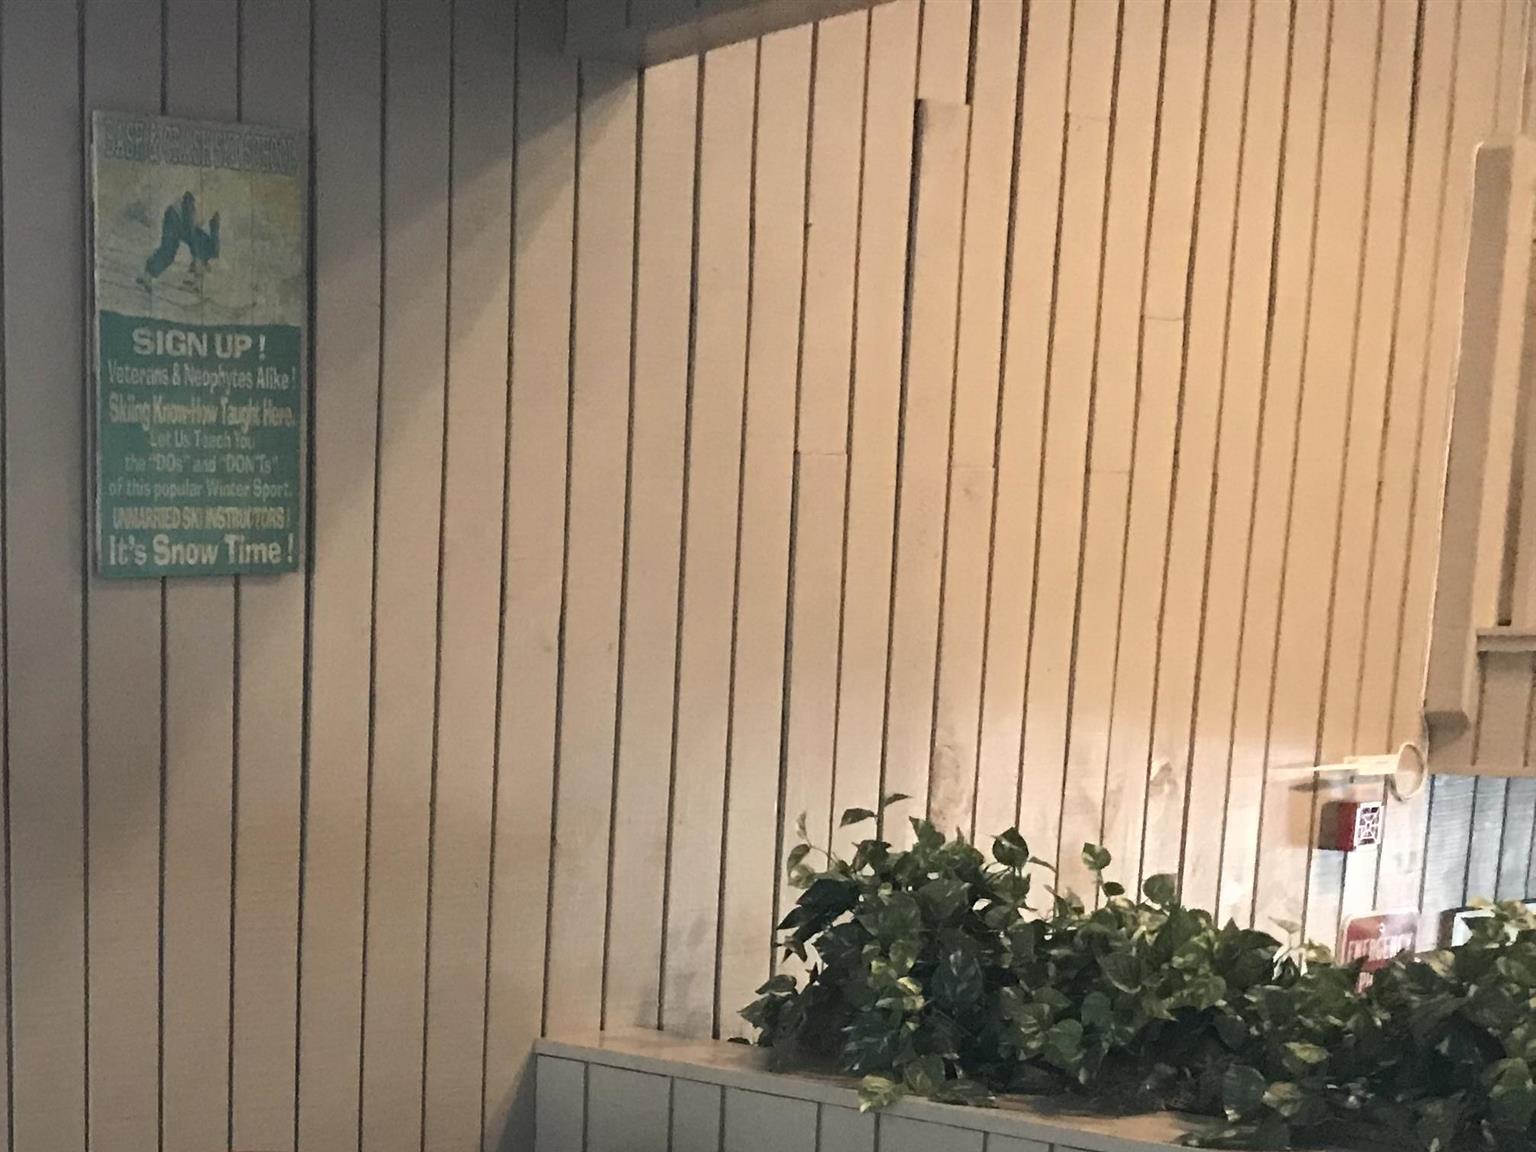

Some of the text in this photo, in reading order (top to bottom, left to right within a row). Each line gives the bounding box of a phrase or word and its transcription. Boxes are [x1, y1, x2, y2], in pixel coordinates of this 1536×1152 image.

[132, 328, 208, 357] SIGN
[107, 360, 169, 386] Veterans
[172, 361, 182, 386] &
[183, 361, 252, 395] Neophytes
[109, 392, 151, 431] Skiing
[220, 396, 261, 433] Taught
[174, 429, 192, 448] Us
[194, 429, 231, 450] Teach
[108, 477, 122, 495] of
[126, 477, 151, 497] this
[153, 478, 202, 501] popular
[205, 479, 250, 498] Winter
[109, 534, 147, 566] It's
[152, 533, 219, 566] Snow
